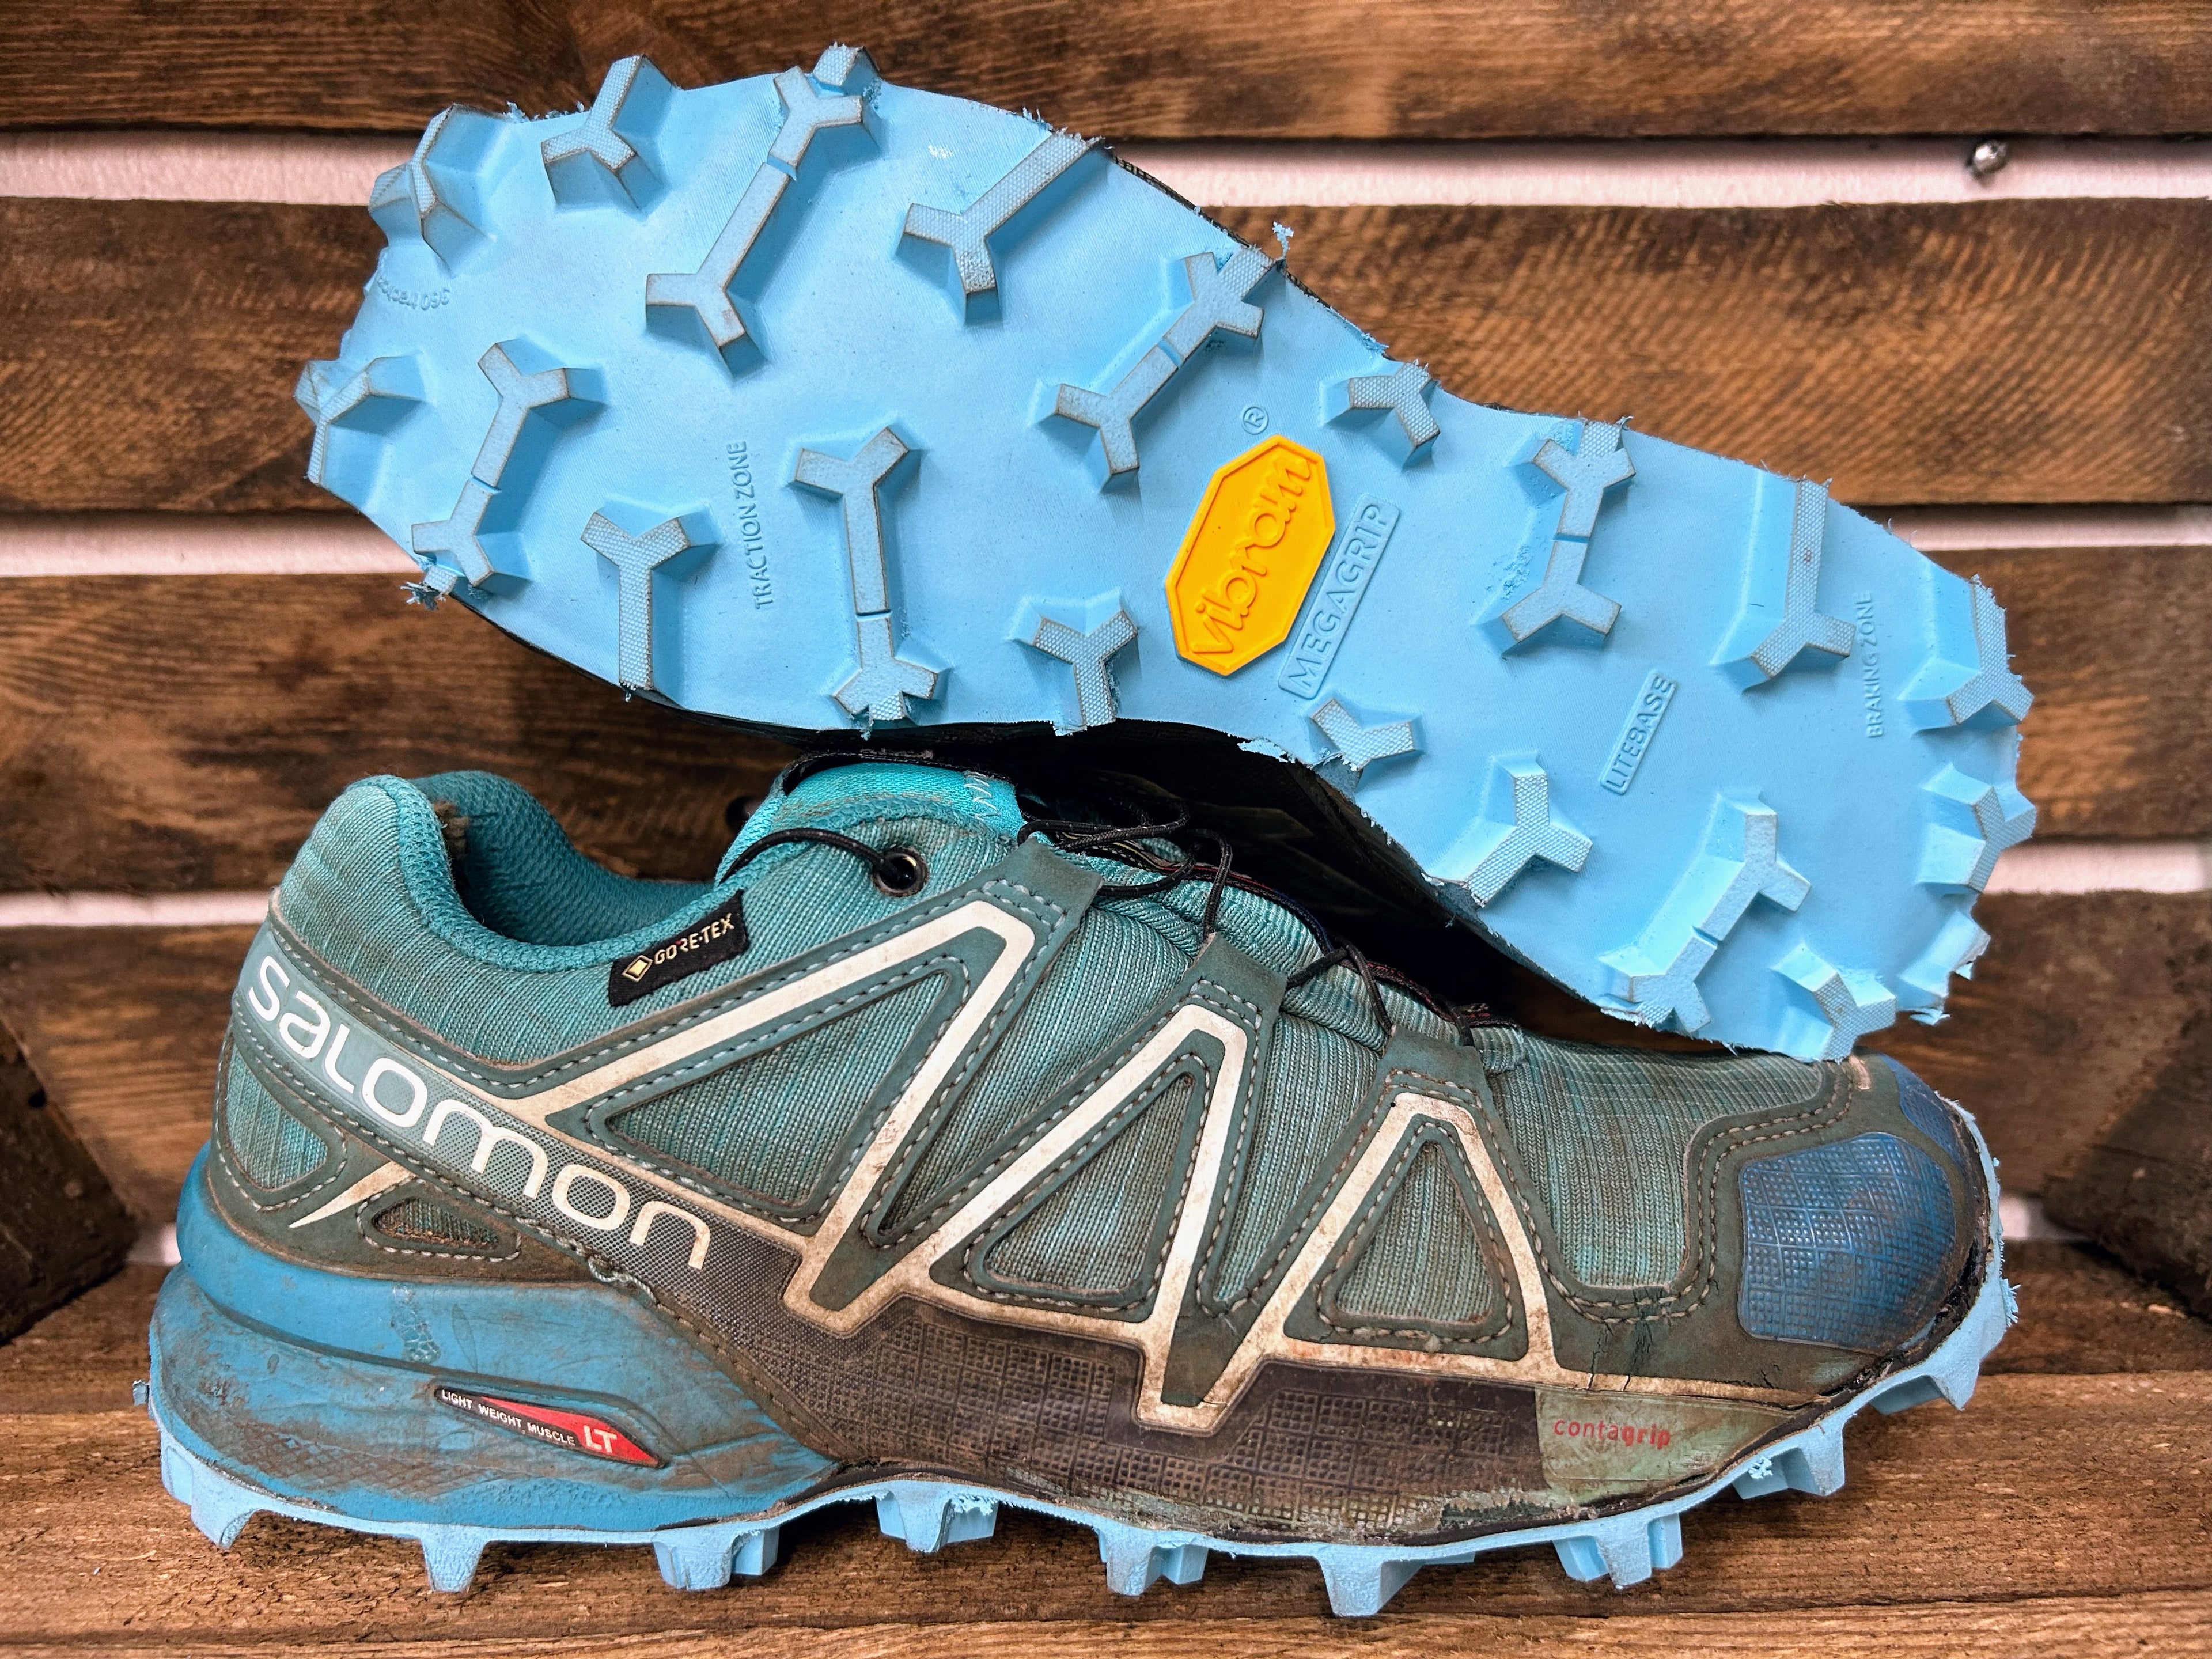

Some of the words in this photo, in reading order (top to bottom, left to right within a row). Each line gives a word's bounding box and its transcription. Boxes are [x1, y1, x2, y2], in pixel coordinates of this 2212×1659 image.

[726, 440, 755, 499] ZONE
[738, 502, 773, 610] TRACTION
[1190, 455, 1313, 655] Vibram
[1288, 503, 1389, 690] MEGAGRIP
[1853, 589, 1878, 647] ZONE
[1861, 652, 1884, 739] BRAKING
[1605, 676, 1674, 789] LITEBASE
[654, 912, 735, 965] GORE-TEX
[441, 1389, 473, 1411] LIGHT
[478, 1403, 522, 1429] WEIGHT
[527, 1422, 576, 1445] MUSCLE
[583, 1425, 618, 1453] LT
[1553, 1418, 1671, 1450] contagrip
